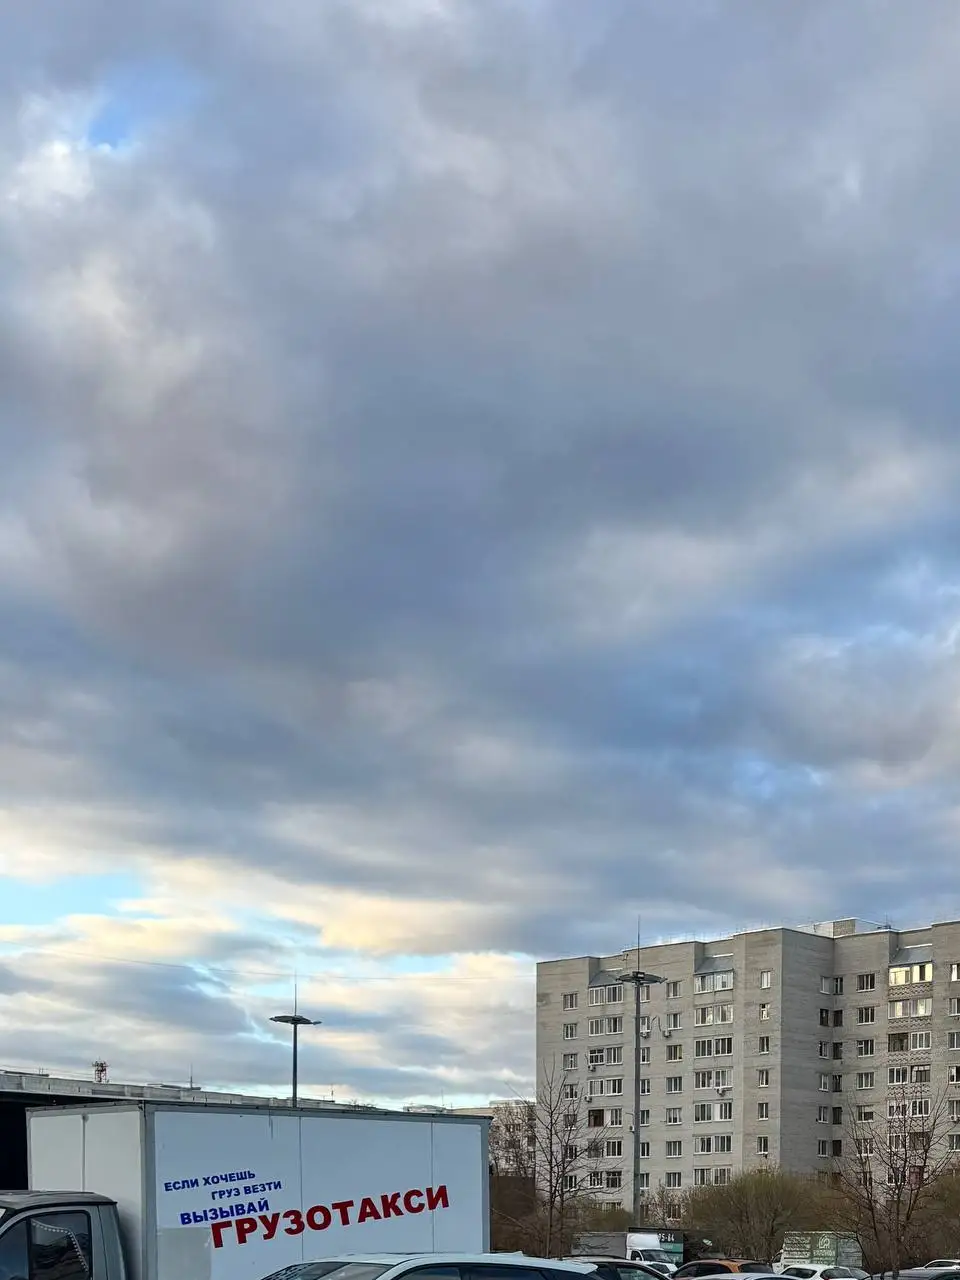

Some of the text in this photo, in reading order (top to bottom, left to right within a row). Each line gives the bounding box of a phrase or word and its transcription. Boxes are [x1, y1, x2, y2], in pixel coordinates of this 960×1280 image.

[164, 1170, 256, 1192] ЕСЛИ ХОЧЕШЬ
[211, 1180, 282, 1200] ГРУЗ ВЕЗТИ
[180, 1197, 270, 1225] ВЫЗЫВАЙ
[210, 1184, 450, 1249] ГРУЗОТАКСИ
